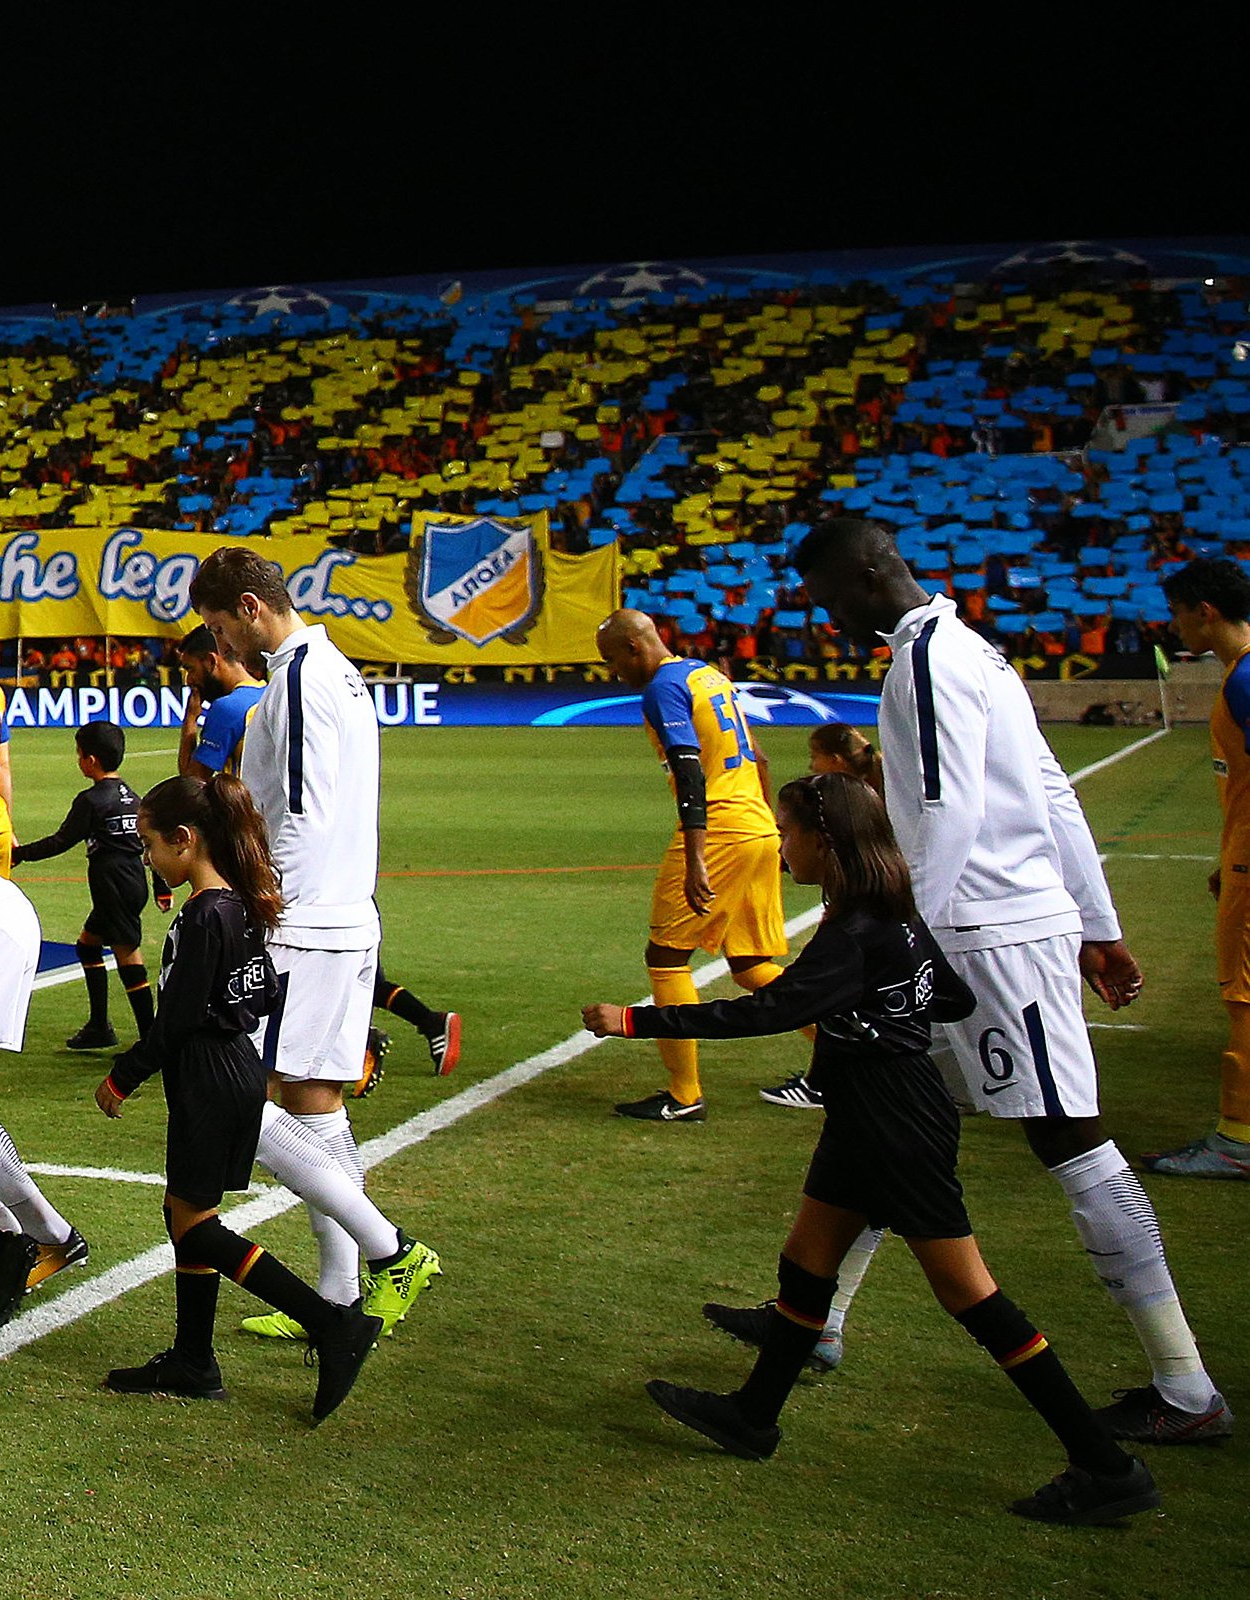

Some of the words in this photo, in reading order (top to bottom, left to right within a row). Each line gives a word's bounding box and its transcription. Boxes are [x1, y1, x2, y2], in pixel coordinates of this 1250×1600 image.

[100, 528, 392, 622] legd...
[6, 686, 212, 727] AMPION
[978, 1026, 1015, 1081] 6
